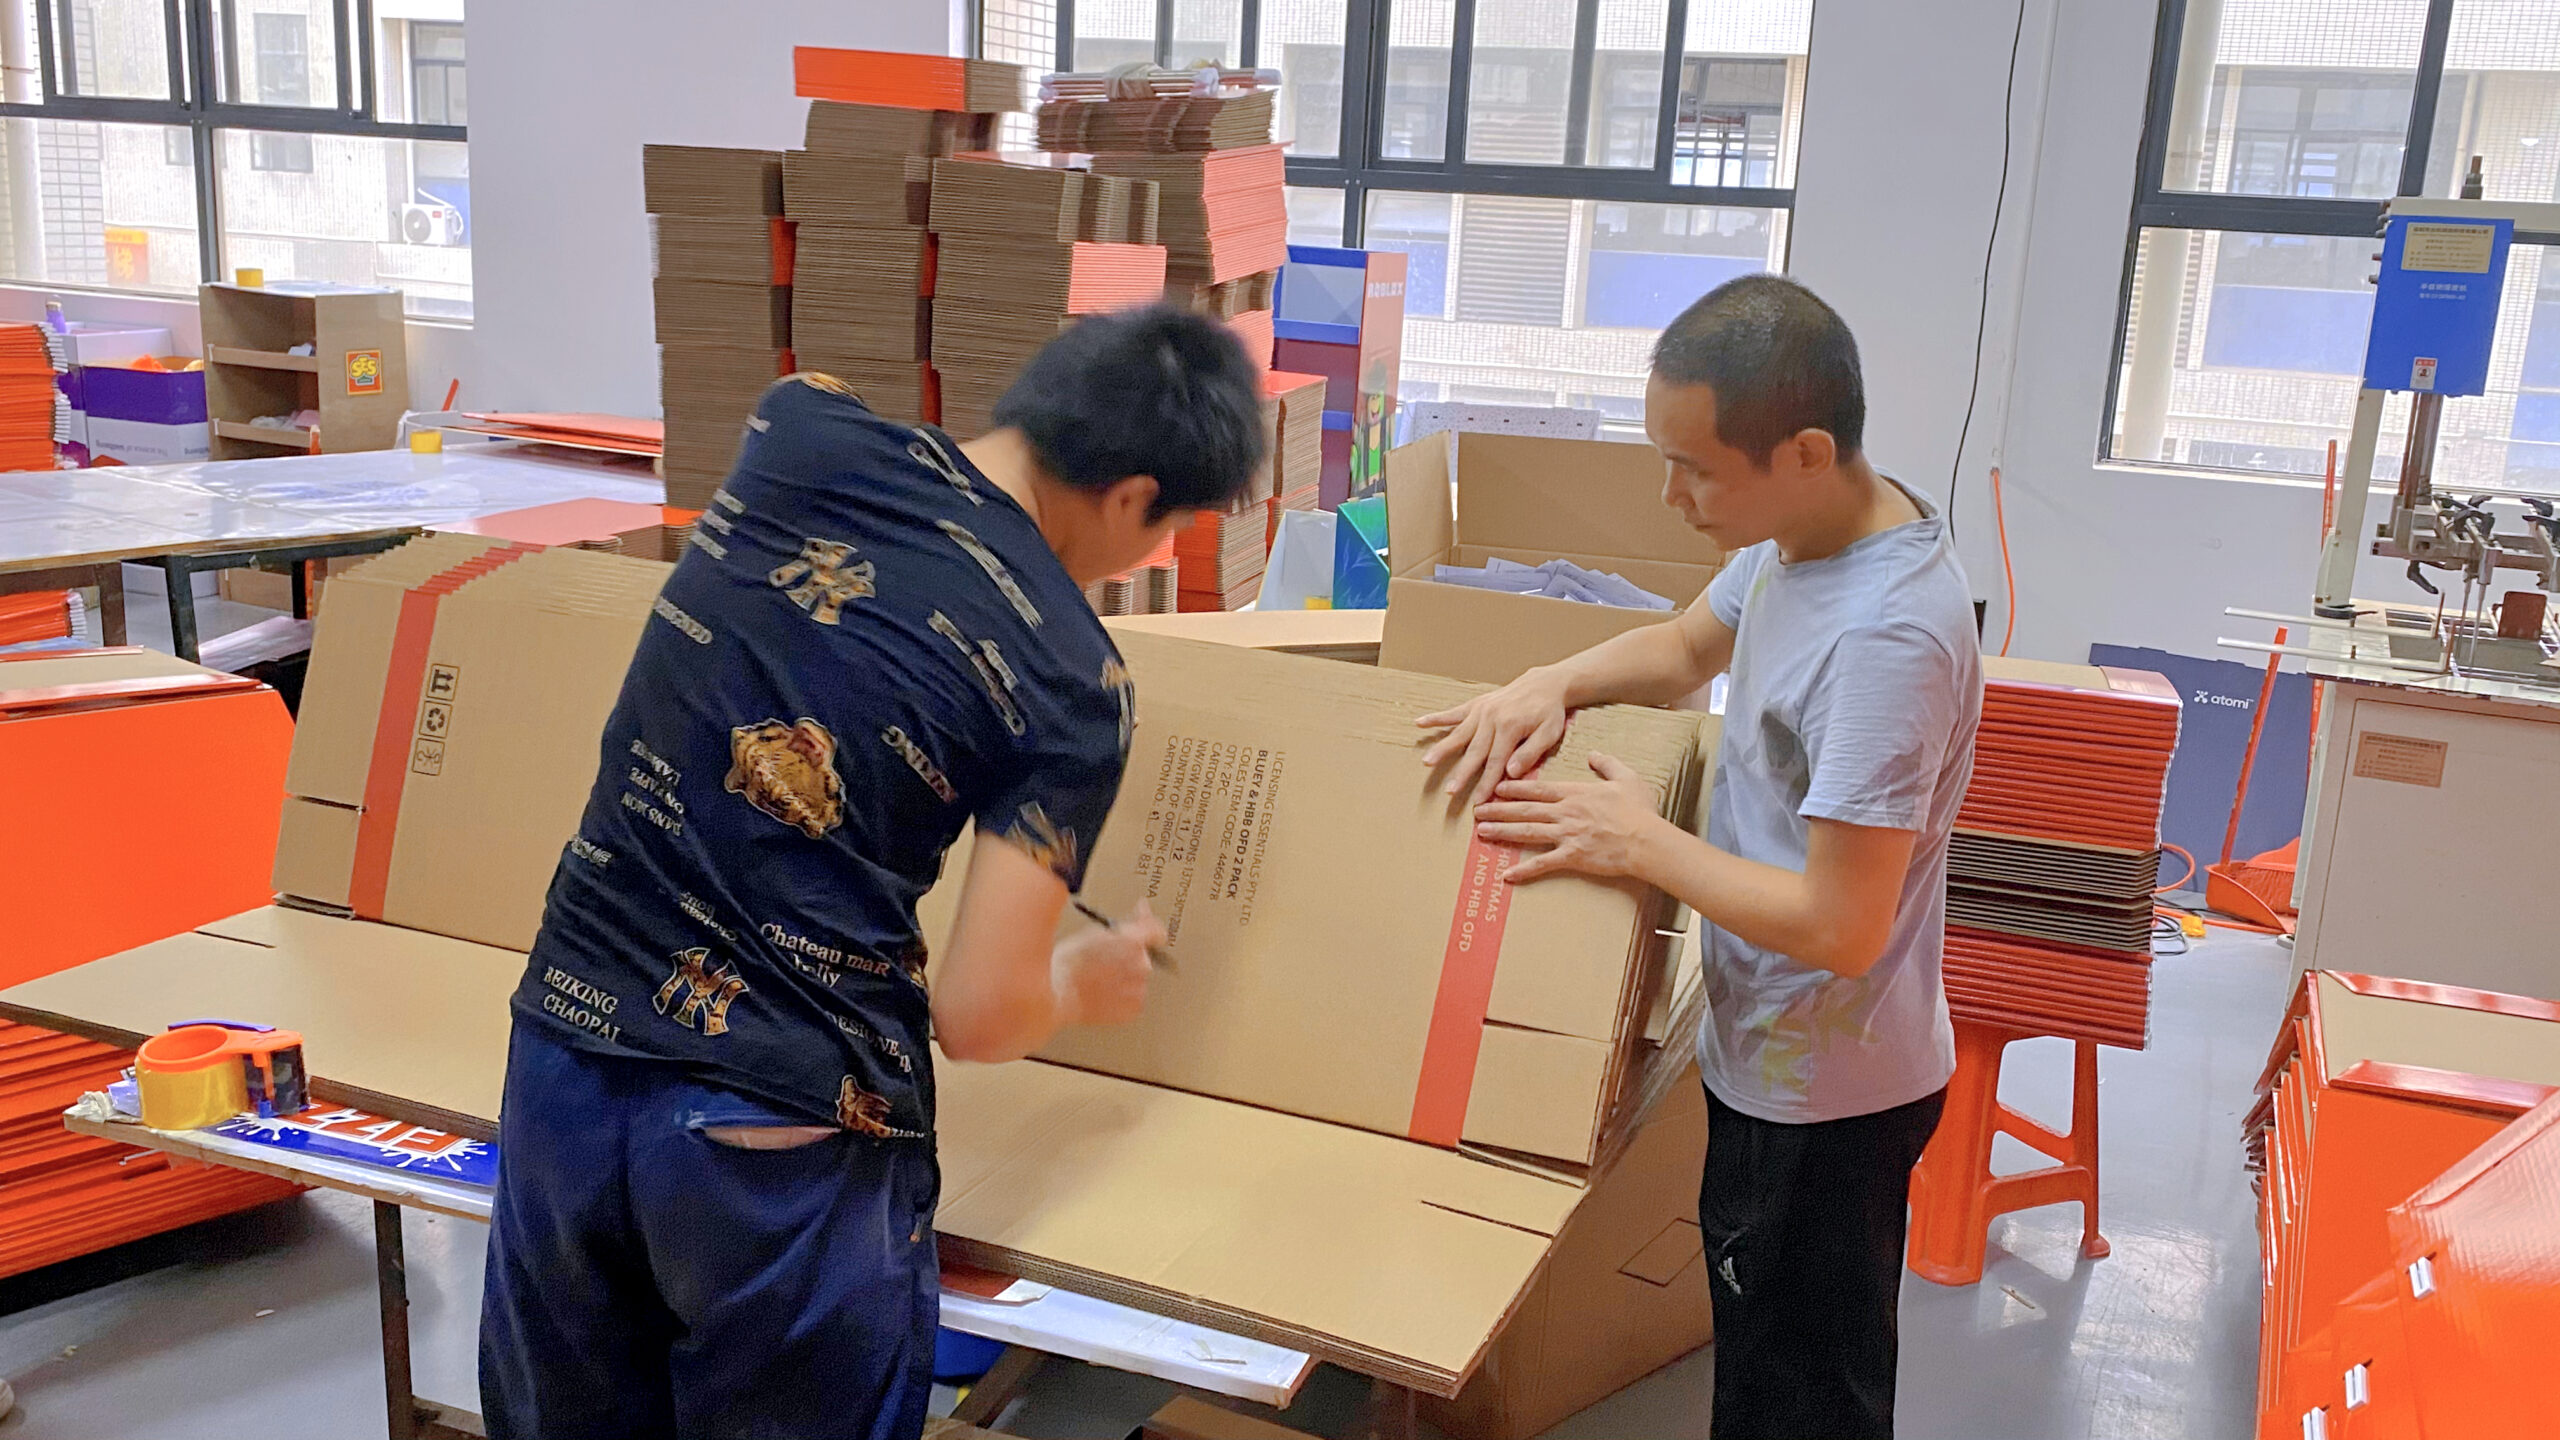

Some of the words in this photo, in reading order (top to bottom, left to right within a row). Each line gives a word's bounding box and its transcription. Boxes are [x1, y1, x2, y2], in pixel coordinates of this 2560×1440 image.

[2211, 695, 2249, 709] atomi
[1159, 734, 1179, 781] CARTON
[1171, 736, 1192, 790] COUNTRY
[1188, 738, 1208, 784] NW/GW
[1202, 741, 1222, 788] CARTON
[1222, 743, 1237, 770] QTY:
[1235, 745, 1252, 782] COLES
[1251, 749, 1268, 788] BLUEY
[1216, 771, 1231, 796] 2PC
[1248, 789, 1258, 799] &
[1263, 750, 1285, 810] LICENSING
[1167, 792, 1180, 809] OF
[1228, 784, 1243, 811] ITEM
[1184, 790, 1211, 865] DIMENSIONS:
[1242, 801, 1255, 826] HBB
[1142, 833, 1154, 849] OF
[1157, 810, 1176, 854] ORIGIN:
[1235, 828, 1249, 855] OFD
[1248, 812, 1272, 878] ESSENTIALS
[1135, 853, 1150, 875] 831
[1233, 856, 1243, 864] 2
[1473, 853, 1489, 887] AND
[1145, 855, 1166, 899] CHINA
[1225, 867, 1241, 899] PACK
[1243, 879, 1257, 902] PTY
[1484, 846, 1511, 922] HRISTMAS
[1238, 904, 1252, 927] LTD
[1465, 888, 1482, 918] HBB
[760, 922, 842, 963] Chateau
[1459, 921, 1474, 951] OFD
